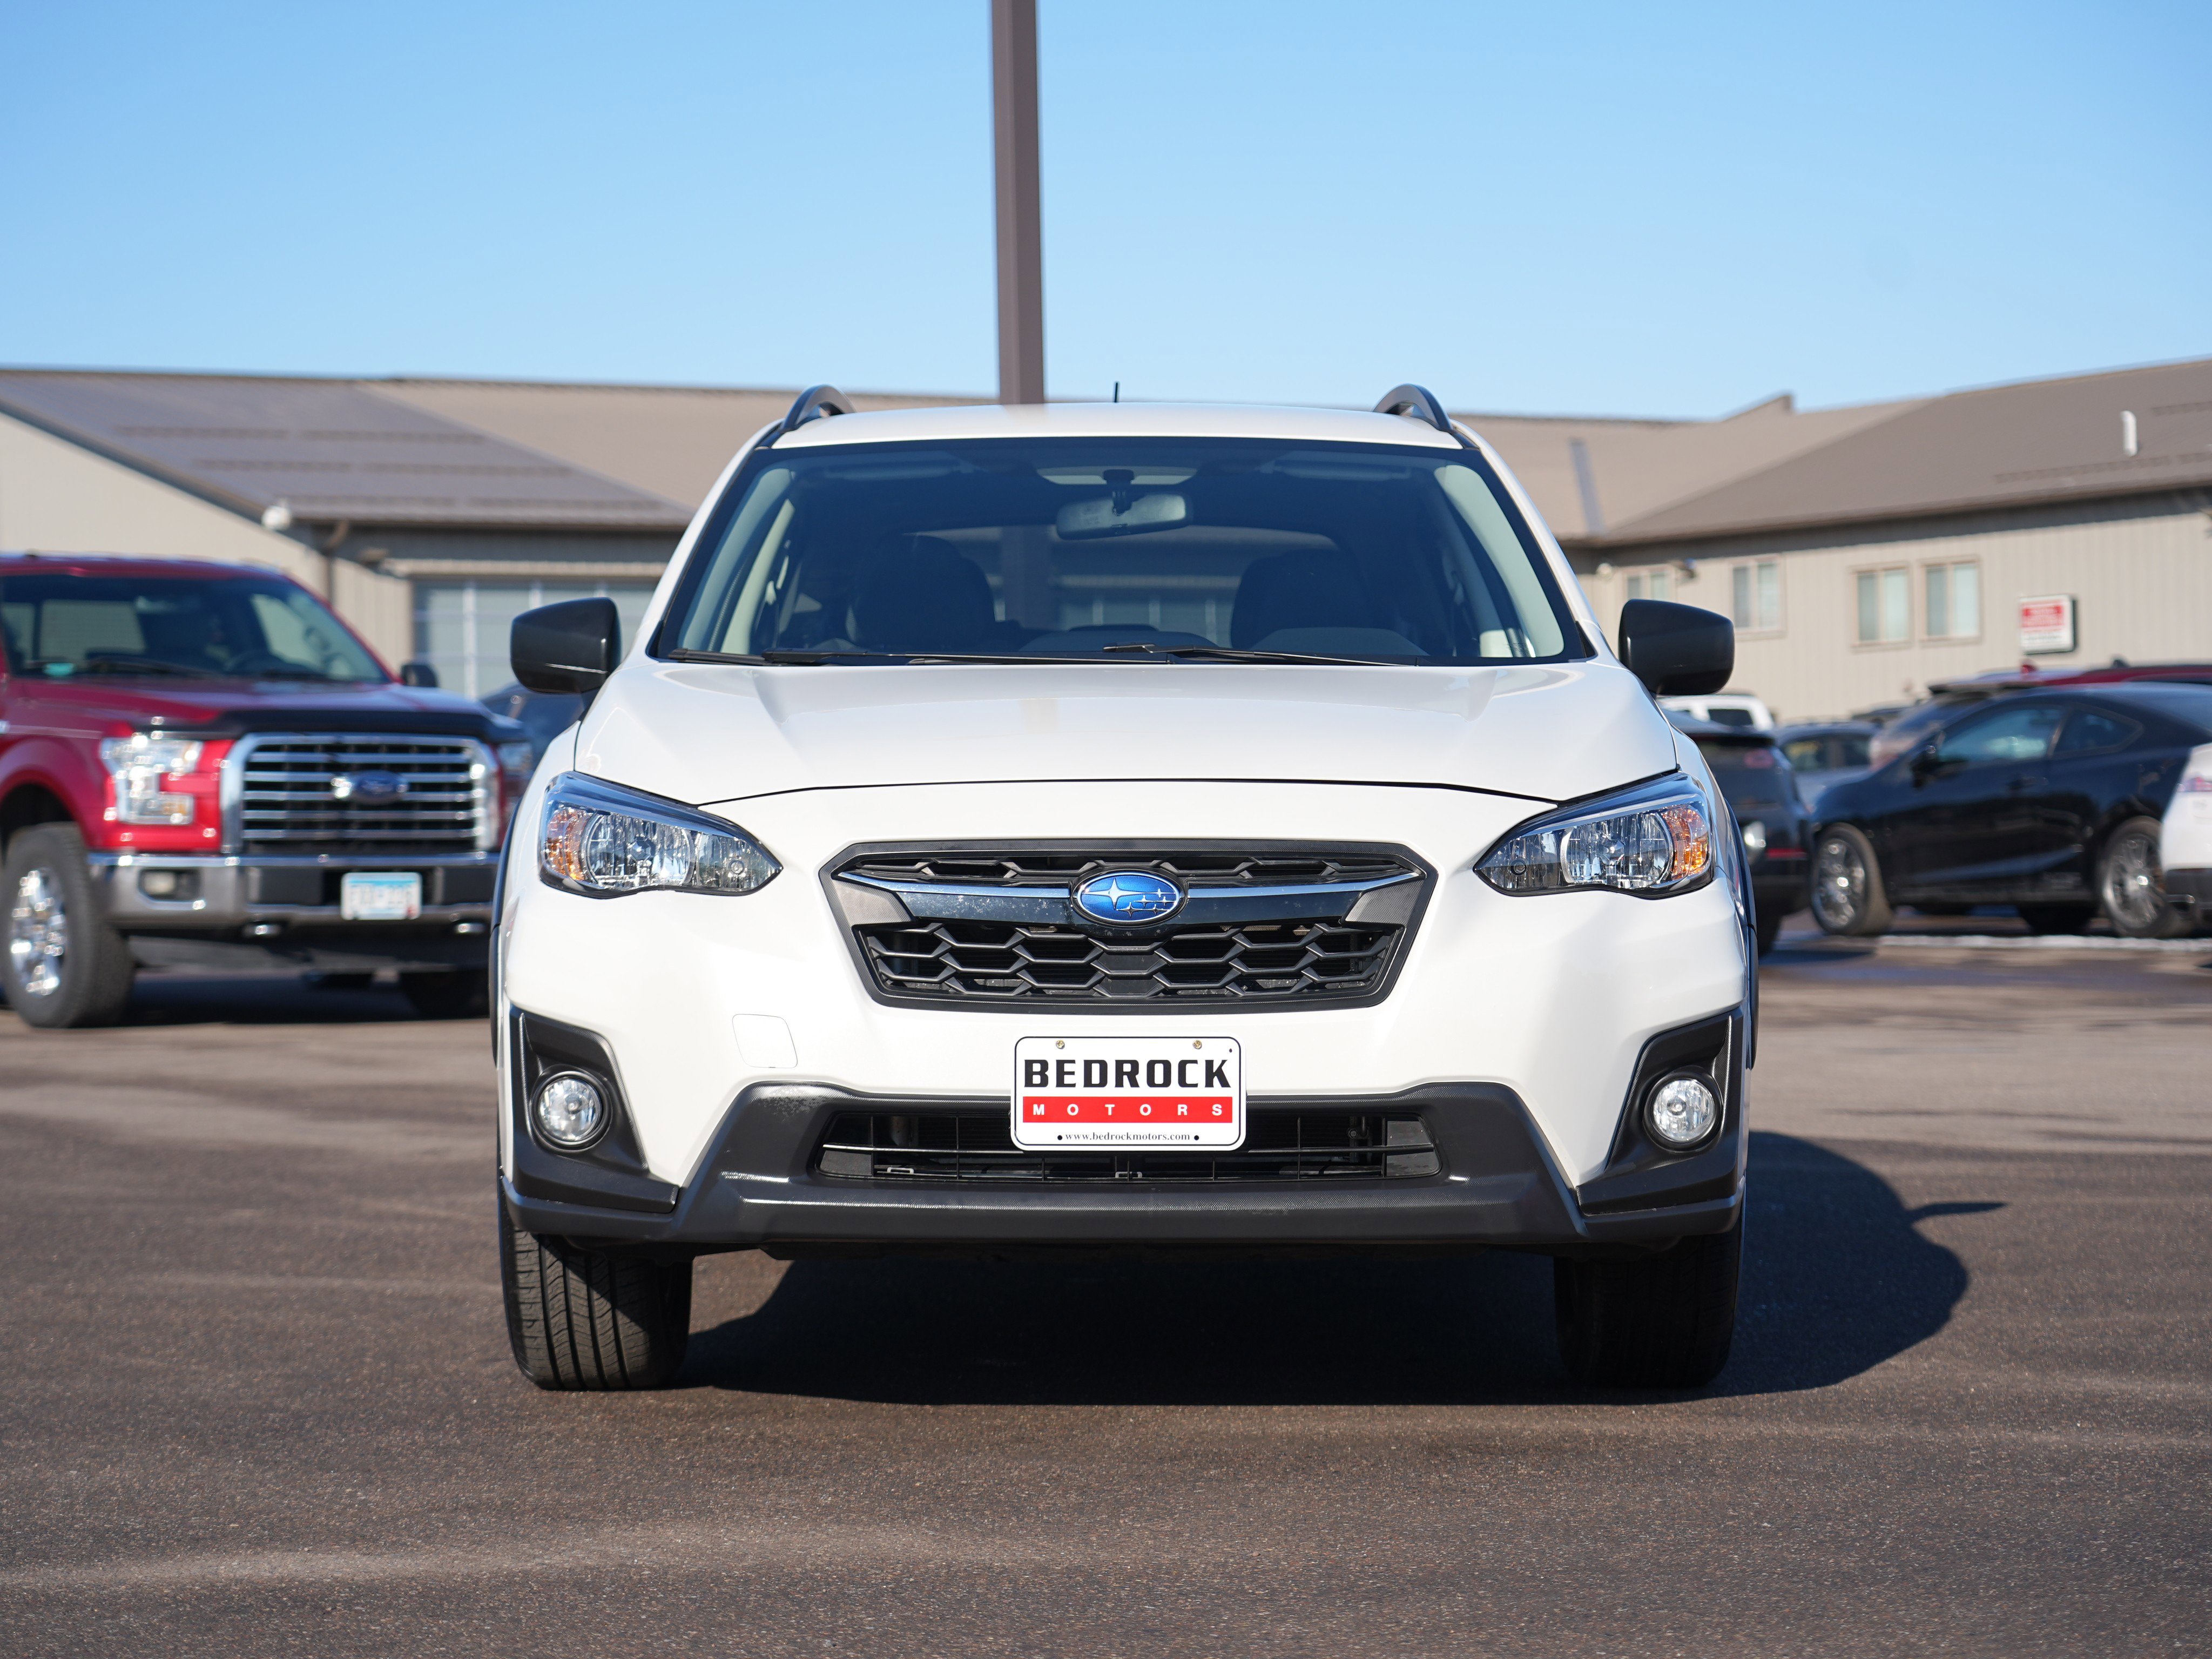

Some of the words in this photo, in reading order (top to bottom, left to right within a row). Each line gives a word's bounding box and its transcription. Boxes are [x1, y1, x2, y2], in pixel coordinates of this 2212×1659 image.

[1024, 1060, 1231, 1088] BEDROCK
[1033, 1103, 1222, 1116] MOTORS
[1065, 1132, 1190, 1141] www.bedrockmotors.com
